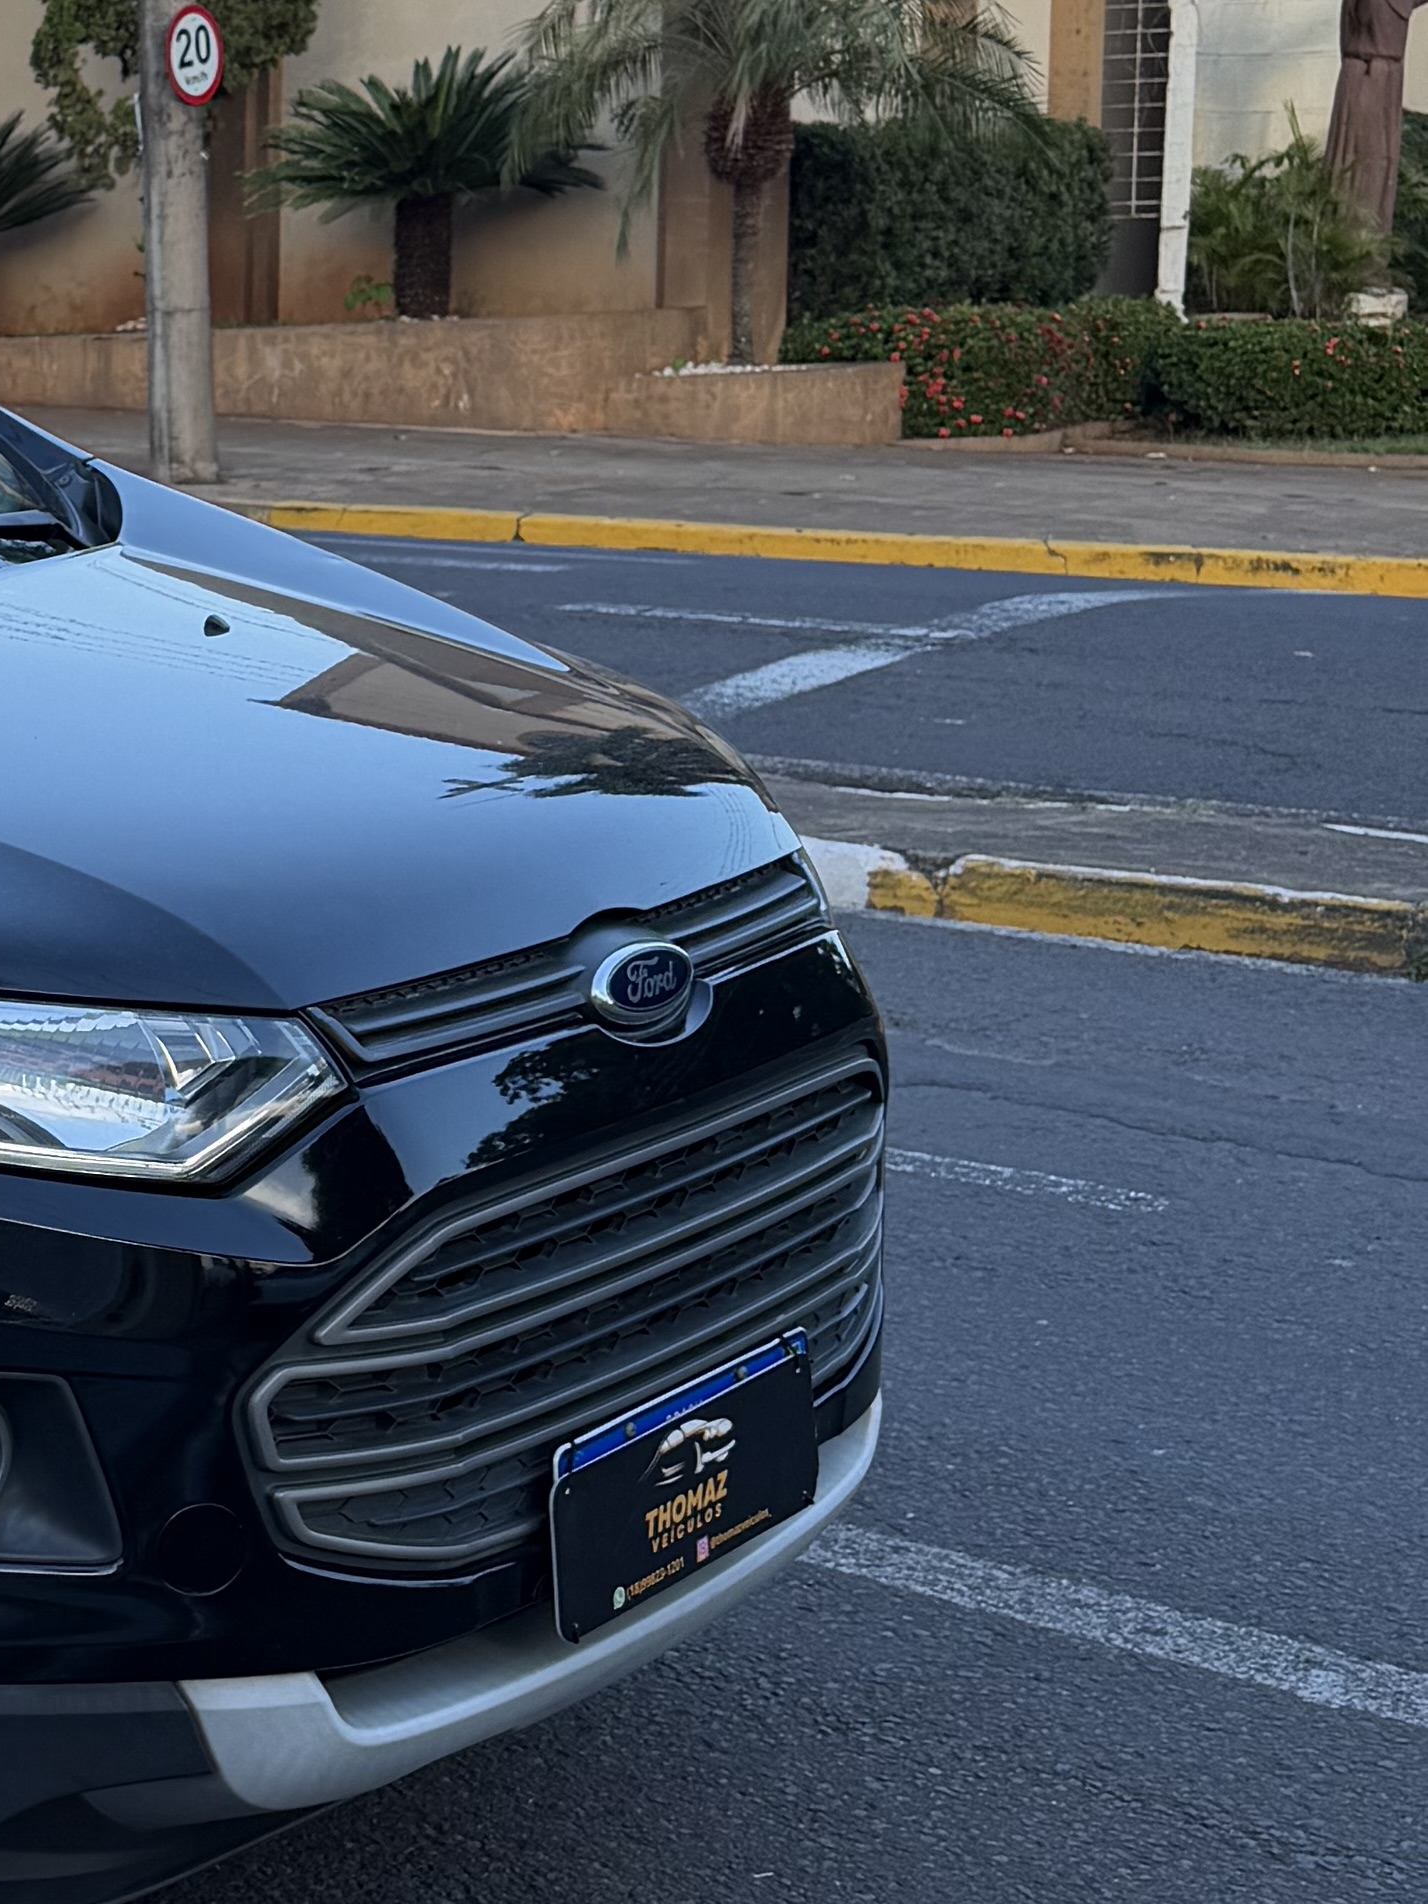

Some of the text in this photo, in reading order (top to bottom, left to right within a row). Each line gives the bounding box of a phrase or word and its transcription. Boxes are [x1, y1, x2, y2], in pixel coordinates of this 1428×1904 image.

[176, 24, 211, 69] 20
[626, 956, 677, 1004] Ford
[645, 1469, 729, 1539] THOMAZ
